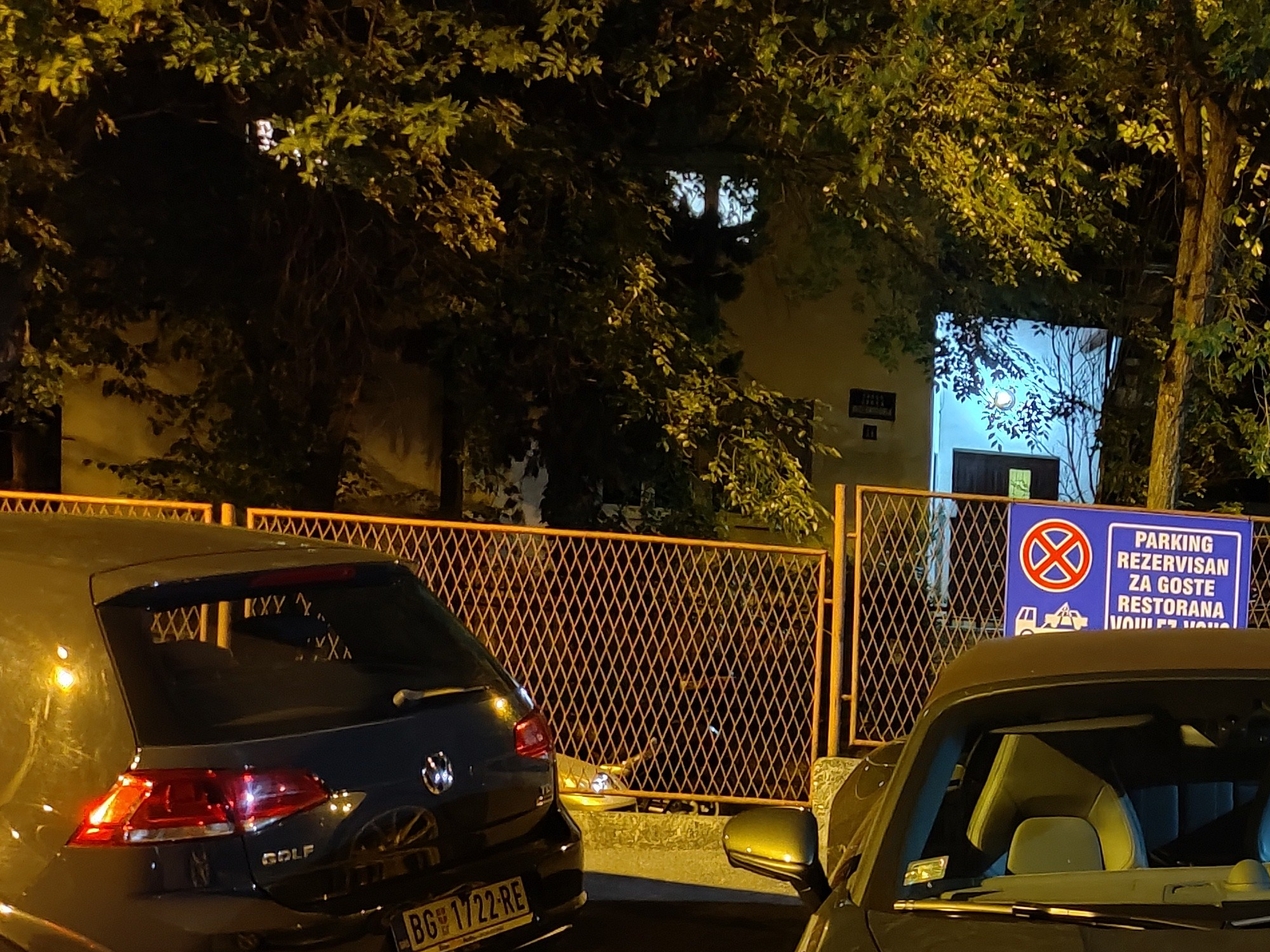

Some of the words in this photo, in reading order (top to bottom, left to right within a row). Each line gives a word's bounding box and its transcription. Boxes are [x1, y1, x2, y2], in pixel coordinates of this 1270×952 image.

[1135, 531, 1213, 553] PARKING
[1117, 552, 1229, 577] REZERVISAN
[1129, 574, 1151, 592] ZA
[1158, 576, 1215, 597] GOSTE
[1117, 595, 1225, 619] RESTORANA
[261, 844, 315, 866] GOLF
[408, 908, 438, 945] BG
